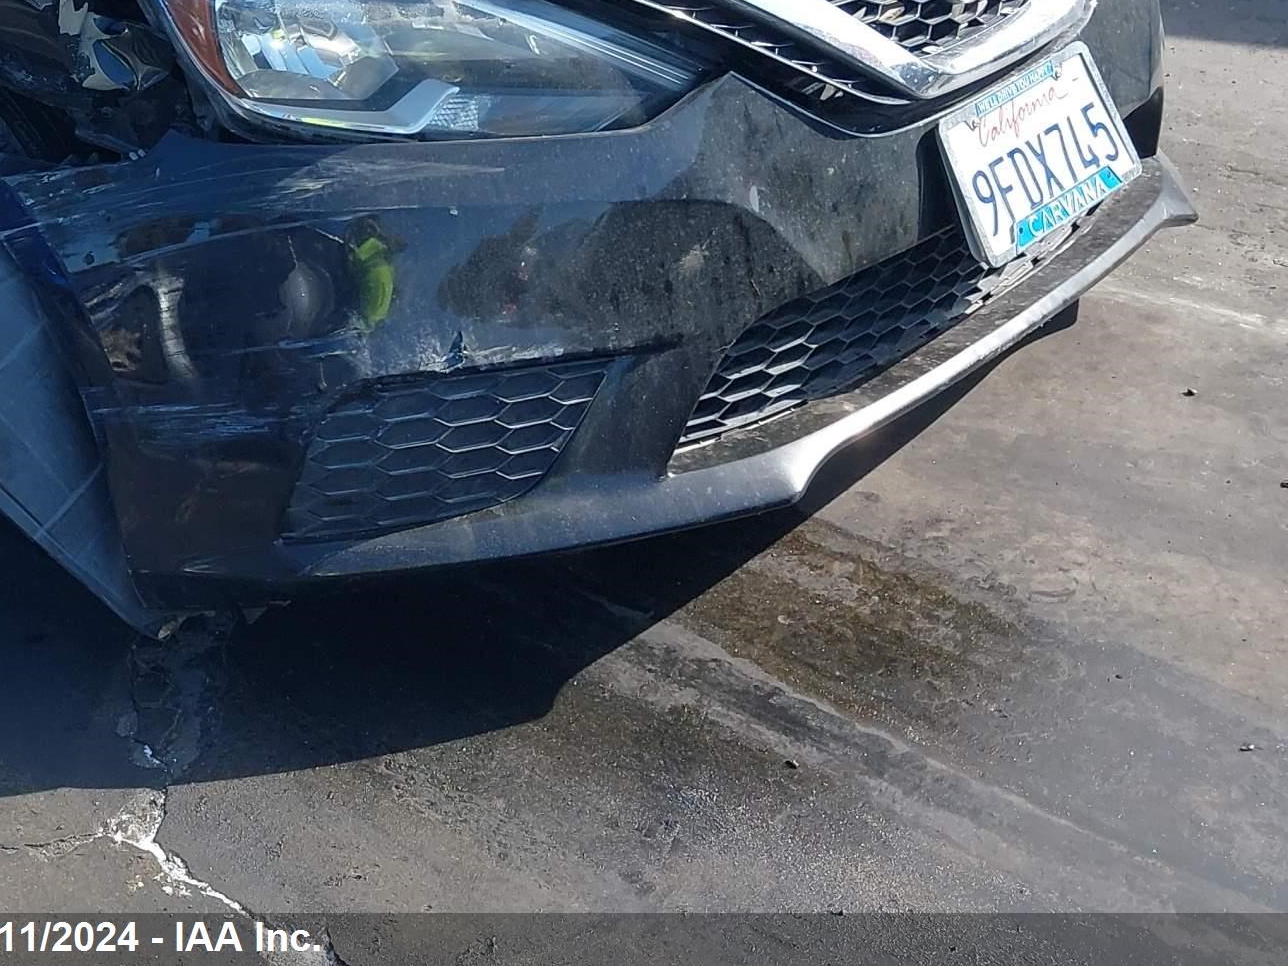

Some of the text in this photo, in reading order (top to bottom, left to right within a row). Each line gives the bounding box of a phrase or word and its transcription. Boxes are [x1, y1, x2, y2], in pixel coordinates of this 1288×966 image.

[977, 85, 1069, 148] California
[972, 101, 1120, 236] 9FDX745
[1027, 176, 1108, 237] CARVANA
